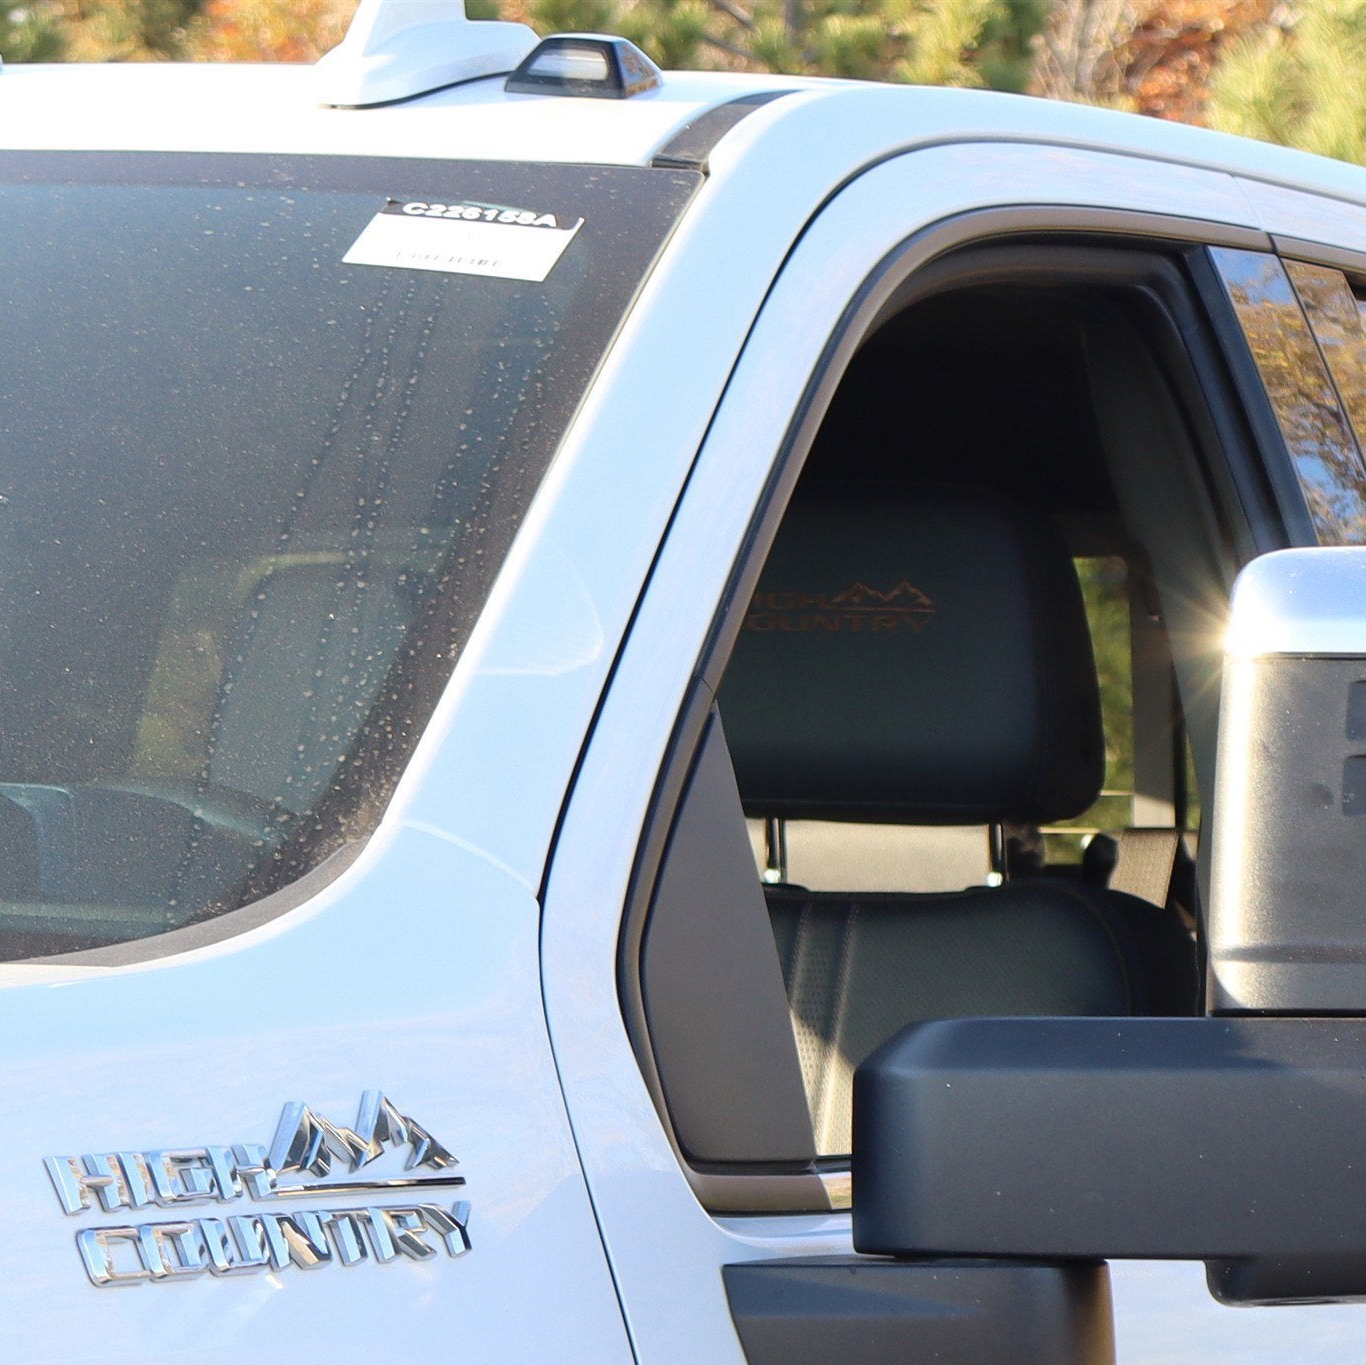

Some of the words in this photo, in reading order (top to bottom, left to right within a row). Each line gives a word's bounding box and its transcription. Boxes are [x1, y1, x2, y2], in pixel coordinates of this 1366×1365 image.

[743, 612, 936, 635] OUNTRY
[43, 1143, 278, 1216] HIGH
[75, 1200, 473, 1288] COUNTRY
